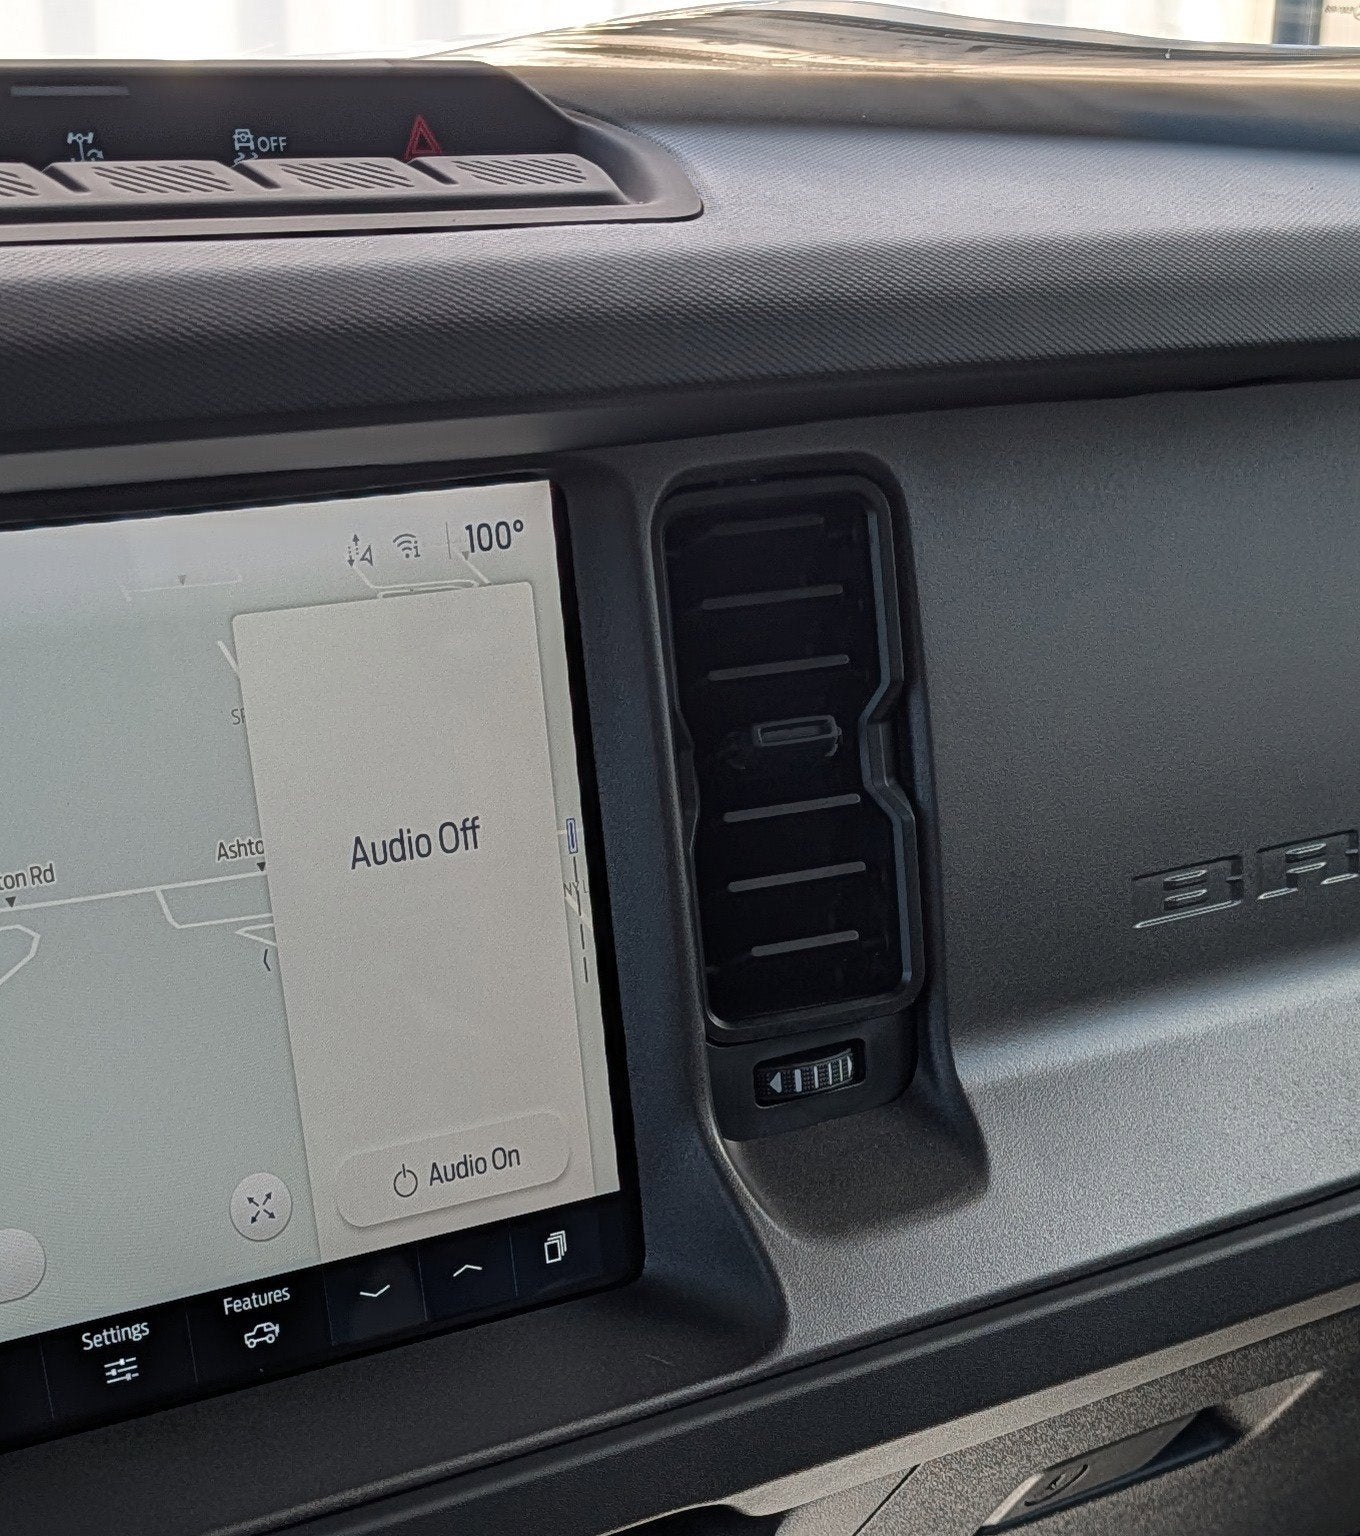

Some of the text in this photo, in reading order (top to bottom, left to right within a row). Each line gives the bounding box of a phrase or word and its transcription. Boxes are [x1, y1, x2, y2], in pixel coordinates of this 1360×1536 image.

[256, 136, 288, 154] OFF
[464, 519, 524, 553] 100°
[350, 816, 481, 870] Audio Off
[30, 862, 56, 885] Rd
[428, 1145, 521, 1187] Audio On
[223, 1285, 291, 1317] Features
[80, 1320, 150, 1353] Settings
